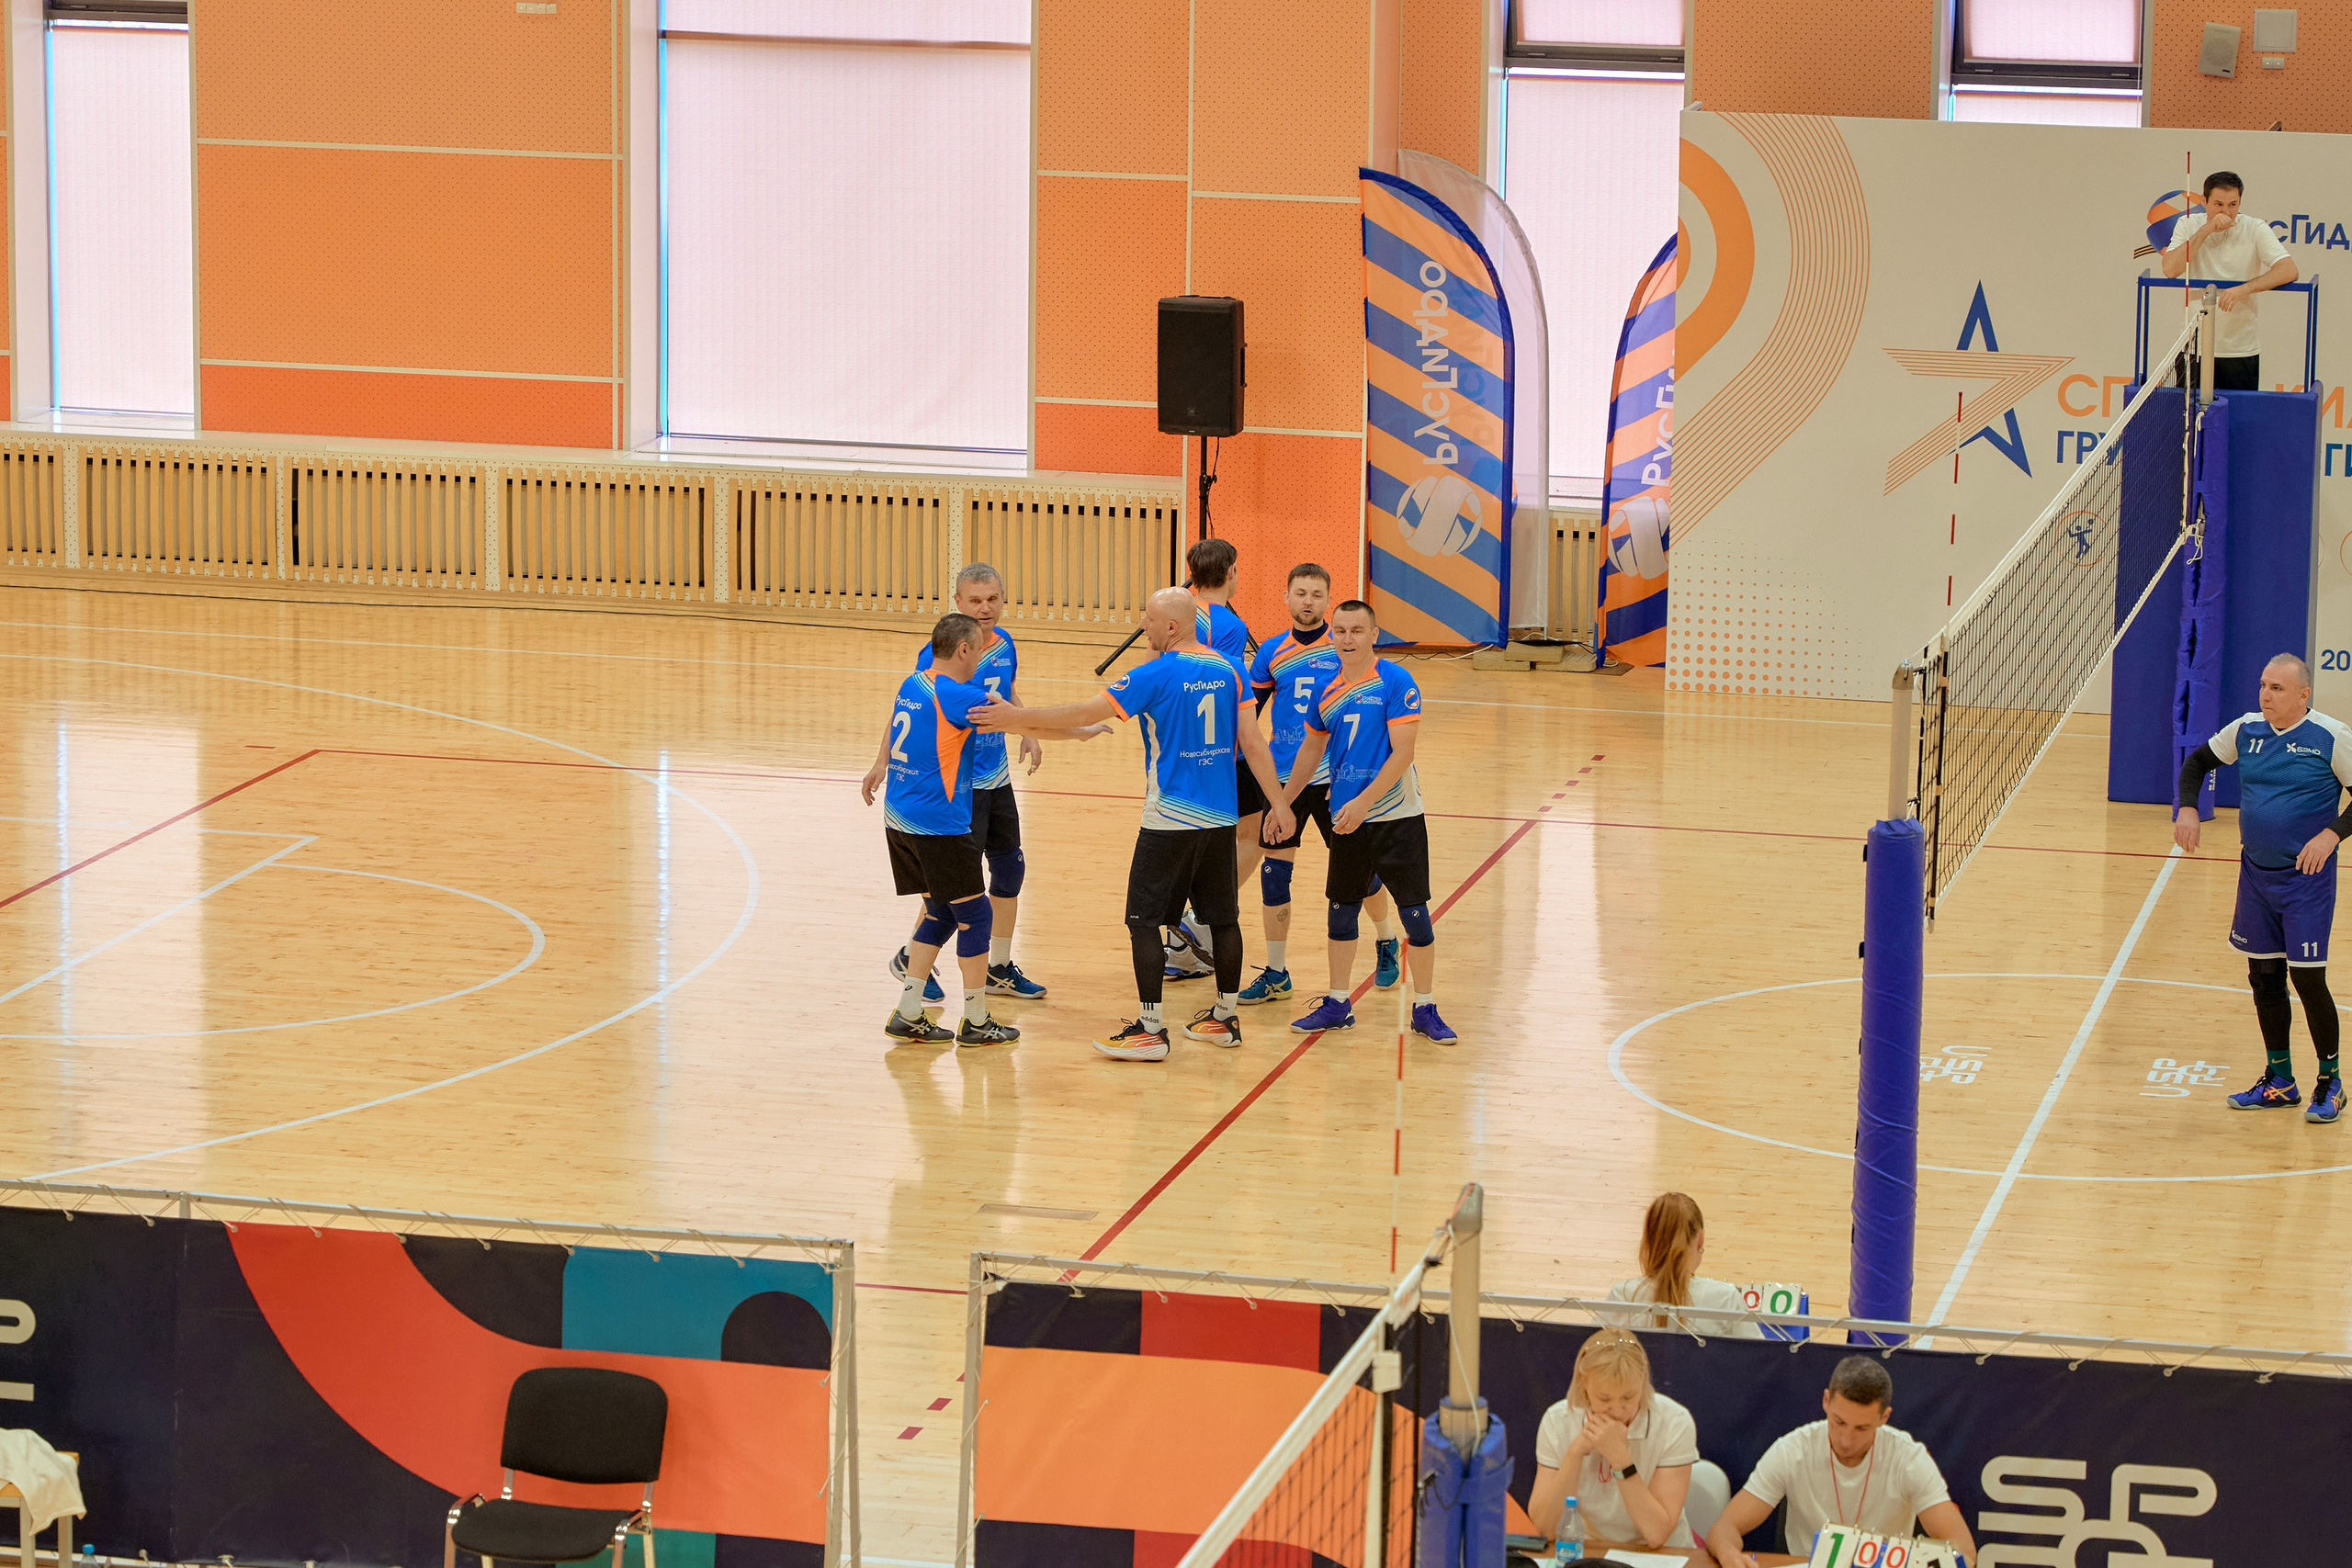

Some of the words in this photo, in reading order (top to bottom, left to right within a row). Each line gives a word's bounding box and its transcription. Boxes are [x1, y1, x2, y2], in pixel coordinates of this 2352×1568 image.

[984, 676, 1003, 701] 3
[1182, 680, 1226, 694] РусГидро
[1294, 676, 1316, 714] 5
[895, 694, 922, 710] РусГидро
[1197, 693, 1216, 745] 1
[890, 711, 911, 763] 2
[1342, 713, 1361, 750] 7
[1180, 747, 1230, 758] Новосибирская
[2248, 738, 2265, 754] 11
[1198, 757, 1214, 766] ГЭС
[2301, 942, 2318, 957] 11
[1141, 1015, 1159, 1024] adidas
[1743, 1291, 1761, 1309] 0
[1770, 1290, 1792, 1314] 0
[1826, 1532, 1845, 1568] 1
[1858, 1540, 1878, 1564] 0
[1885, 1546, 1906, 1568] 0
